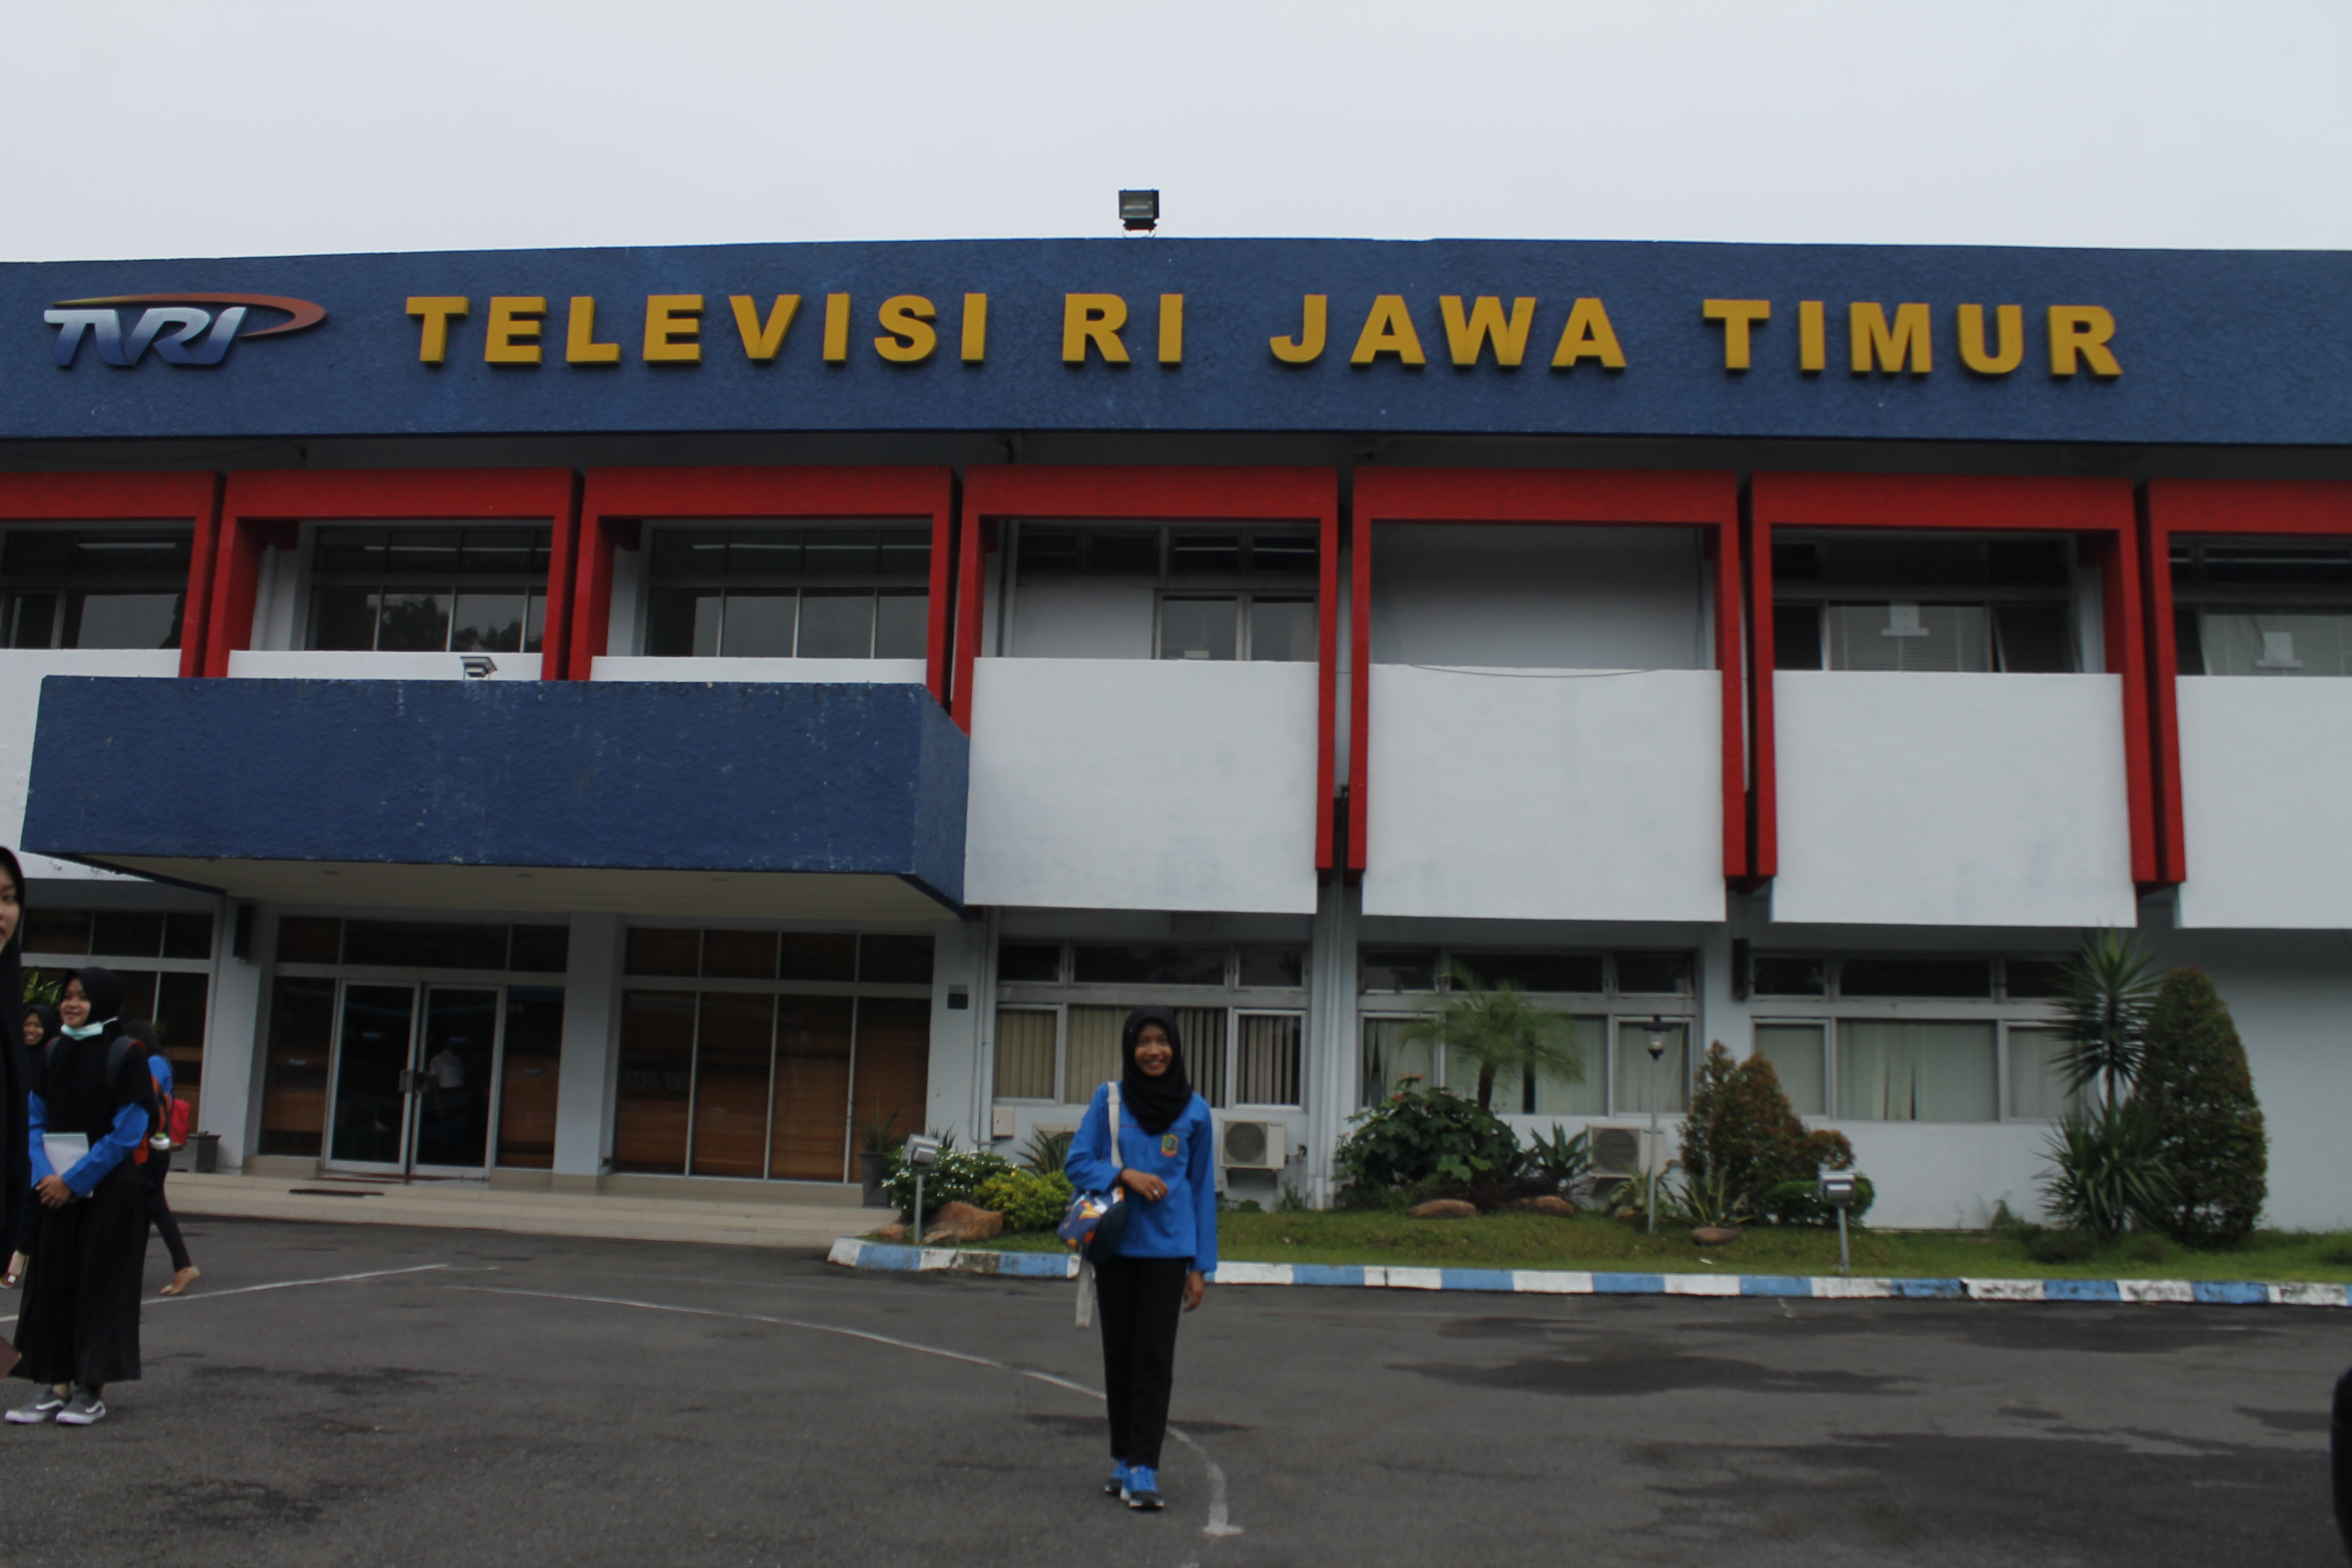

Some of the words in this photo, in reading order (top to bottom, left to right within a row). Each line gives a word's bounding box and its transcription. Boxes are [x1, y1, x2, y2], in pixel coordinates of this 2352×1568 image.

[43, 306, 247, 367] TVRI
[405, 292, 989, 363] TELEVISI
[1061, 293, 1185, 363] RI
[1269, 294, 1627, 368] JAWA
[1702, 299, 2123, 377] TIMUR
